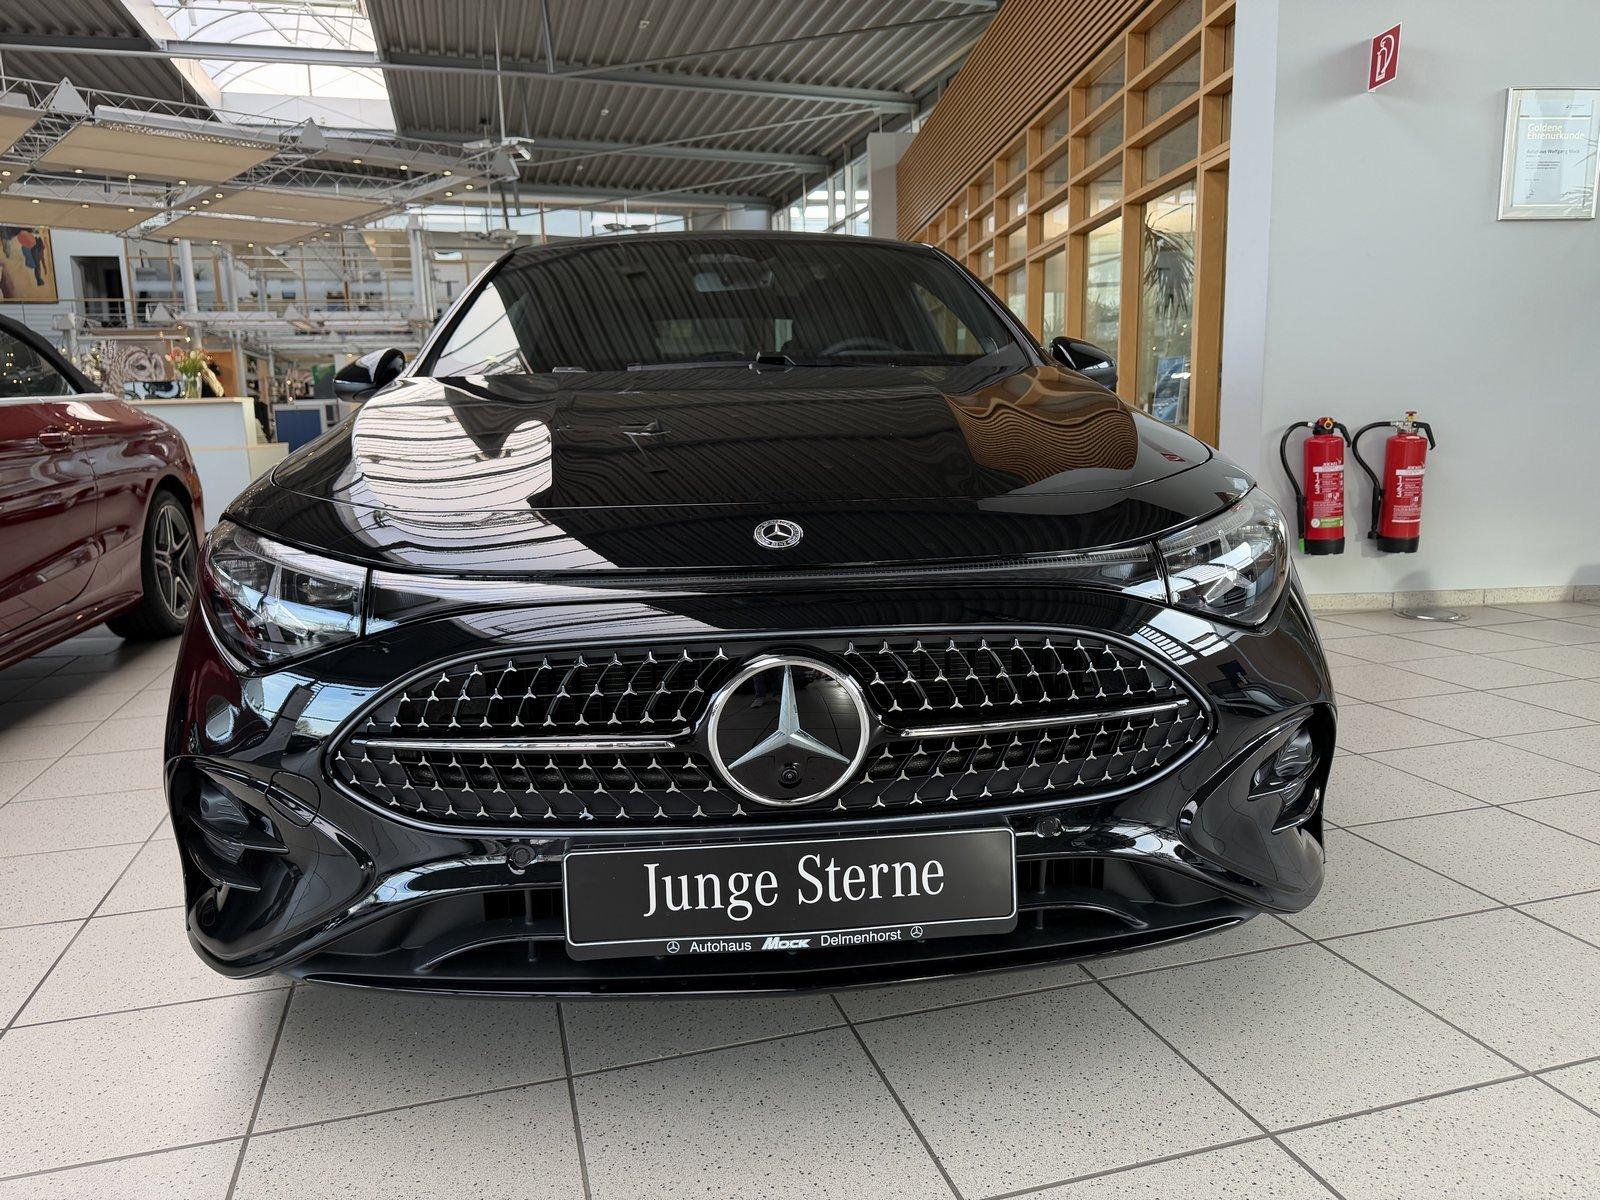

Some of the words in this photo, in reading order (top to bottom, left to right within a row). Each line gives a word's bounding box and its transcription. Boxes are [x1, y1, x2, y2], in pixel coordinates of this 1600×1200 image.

[1527, 130, 1585, 140] Ehrenurkunde
[1528, 123, 1563, 131] Goldene
[643, 863, 778, 921] Junge
[798, 854, 944, 905] Sterne
[690, 940, 751, 952] Autohaus
[820, 929, 901, 946] Delmenhorst
